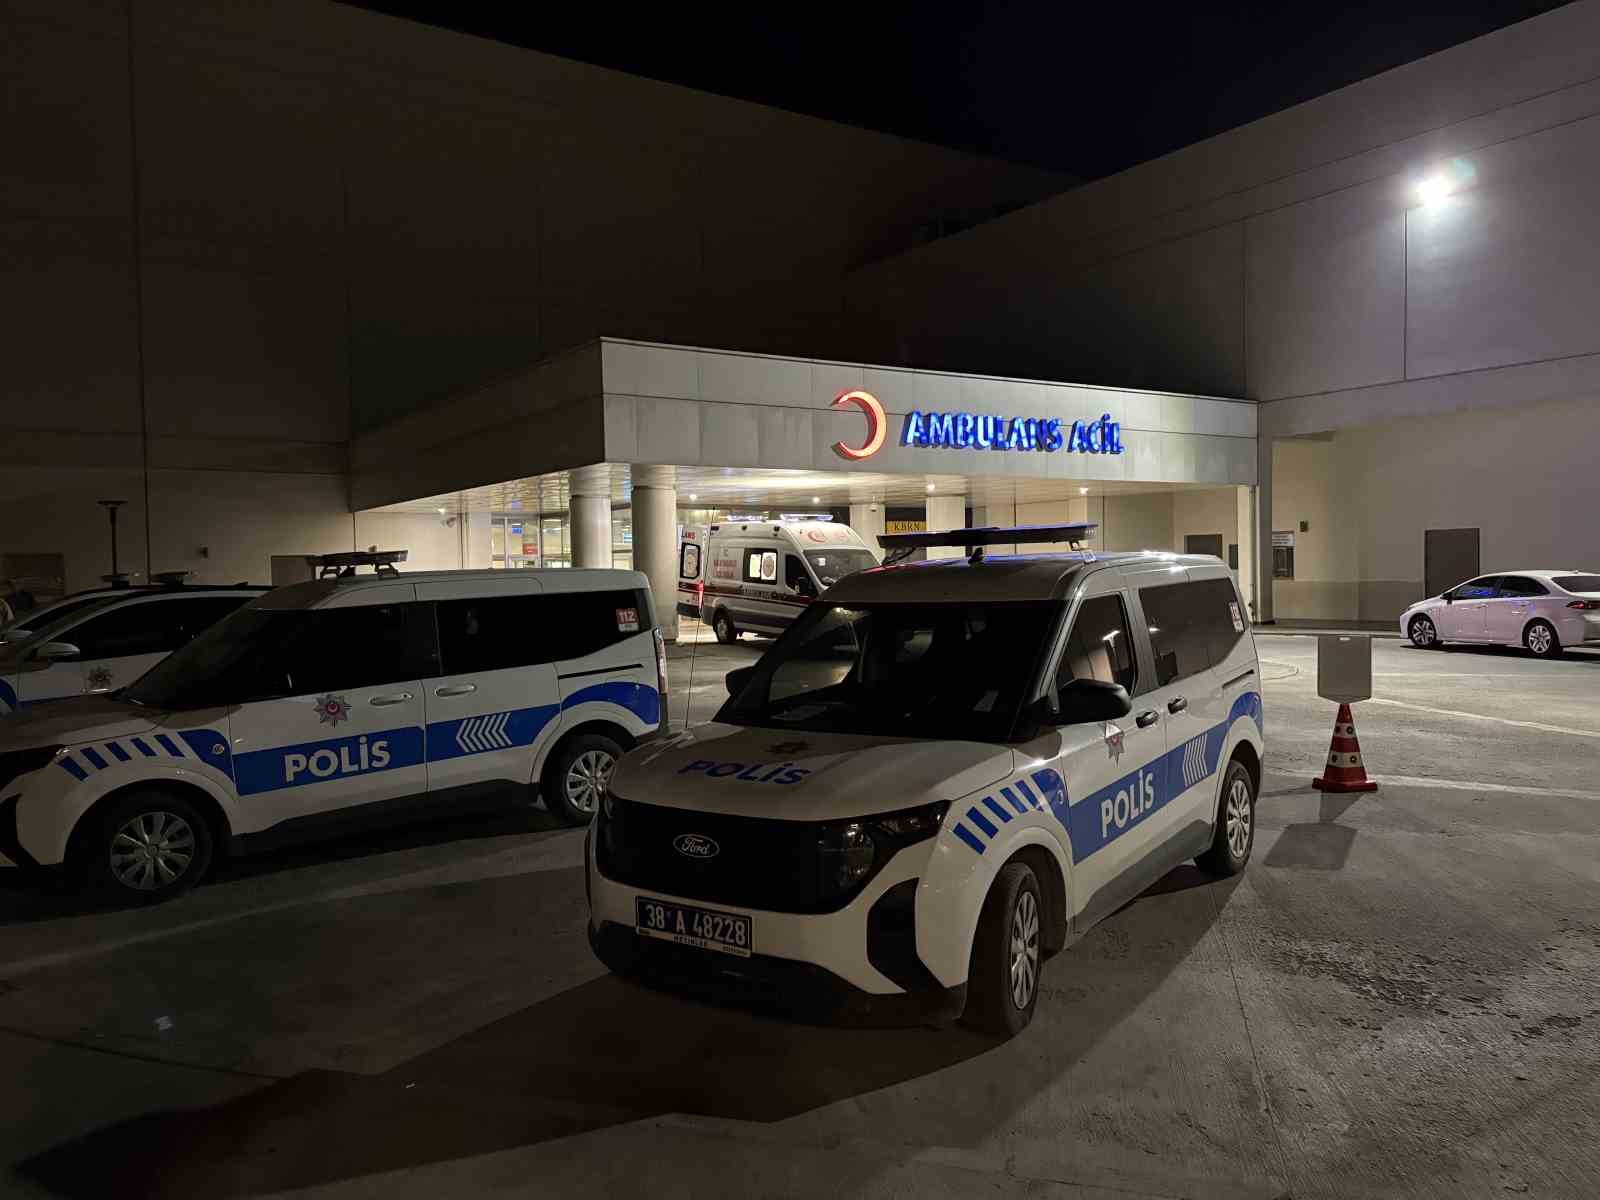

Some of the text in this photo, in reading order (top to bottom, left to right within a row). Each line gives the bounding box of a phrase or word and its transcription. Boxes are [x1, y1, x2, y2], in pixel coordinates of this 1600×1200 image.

[900, 410, 1063, 451] AMBULANS
[618, 611, 636, 623] 112
[284, 735, 391, 783] POLİS
[678, 759, 812, 785] POLİS
[1101, 769, 1154, 838] POLİS
[645, 904, 665, 929] 38
[676, 910, 686, 934] A
[693, 912, 746, 946] 48228
